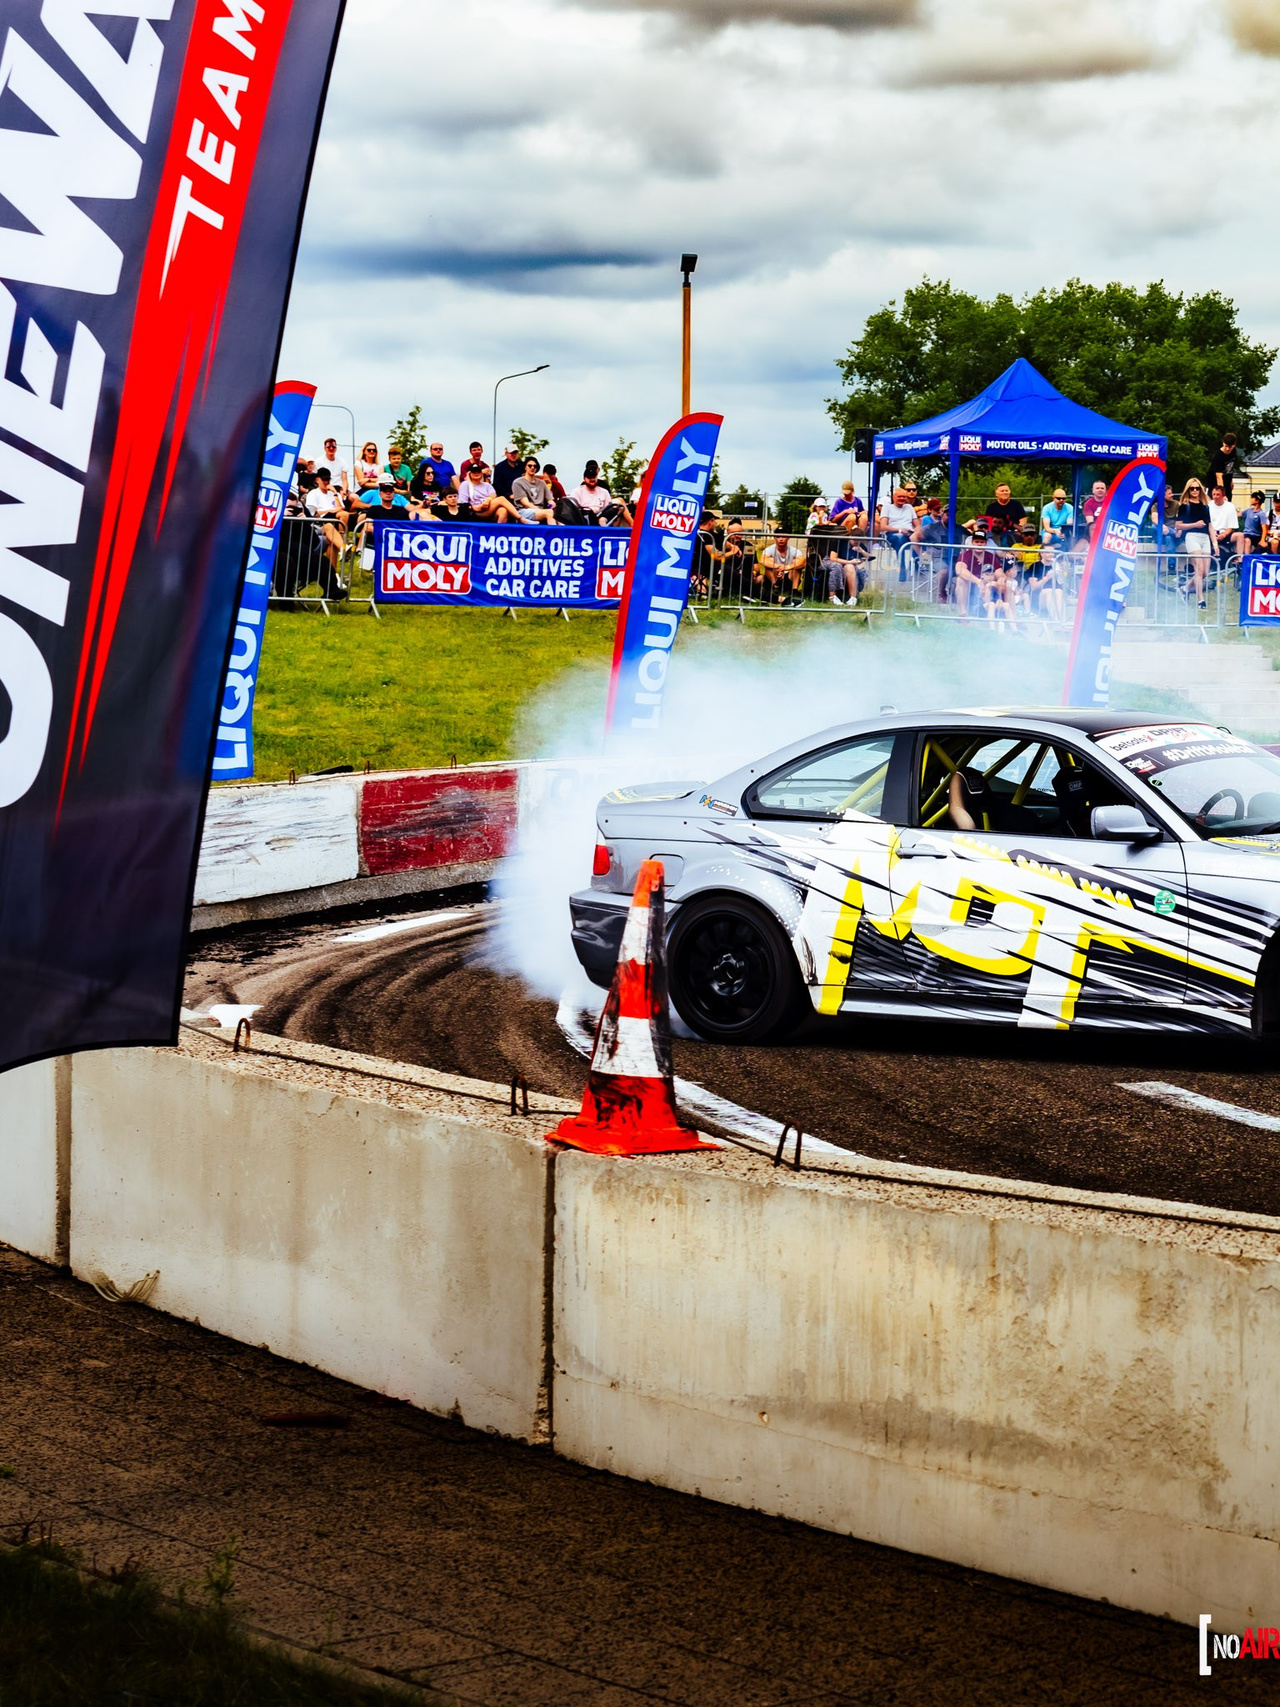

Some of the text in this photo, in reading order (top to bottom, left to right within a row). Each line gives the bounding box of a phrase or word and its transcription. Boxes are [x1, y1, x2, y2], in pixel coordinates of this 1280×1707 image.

[160, 0, 266, 300] TEAM
[986, 440, 1133, 455] MOTOR OILS ADDITIVES CAR CARE
[656, 496, 696, 517] LIQUI
[653, 511, 695, 533] MOLY
[388, 532, 466, 562] LIQUI
[479, 536, 593, 557] MOTOR OILS
[1104, 535, 1137, 556] MOLY
[387, 562, 468, 590] MOLY
[484, 557, 585, 577] ADDITIVES
[486, 578, 581, 598] CAR CARE
[631, 596, 683, 729] LIQUI
